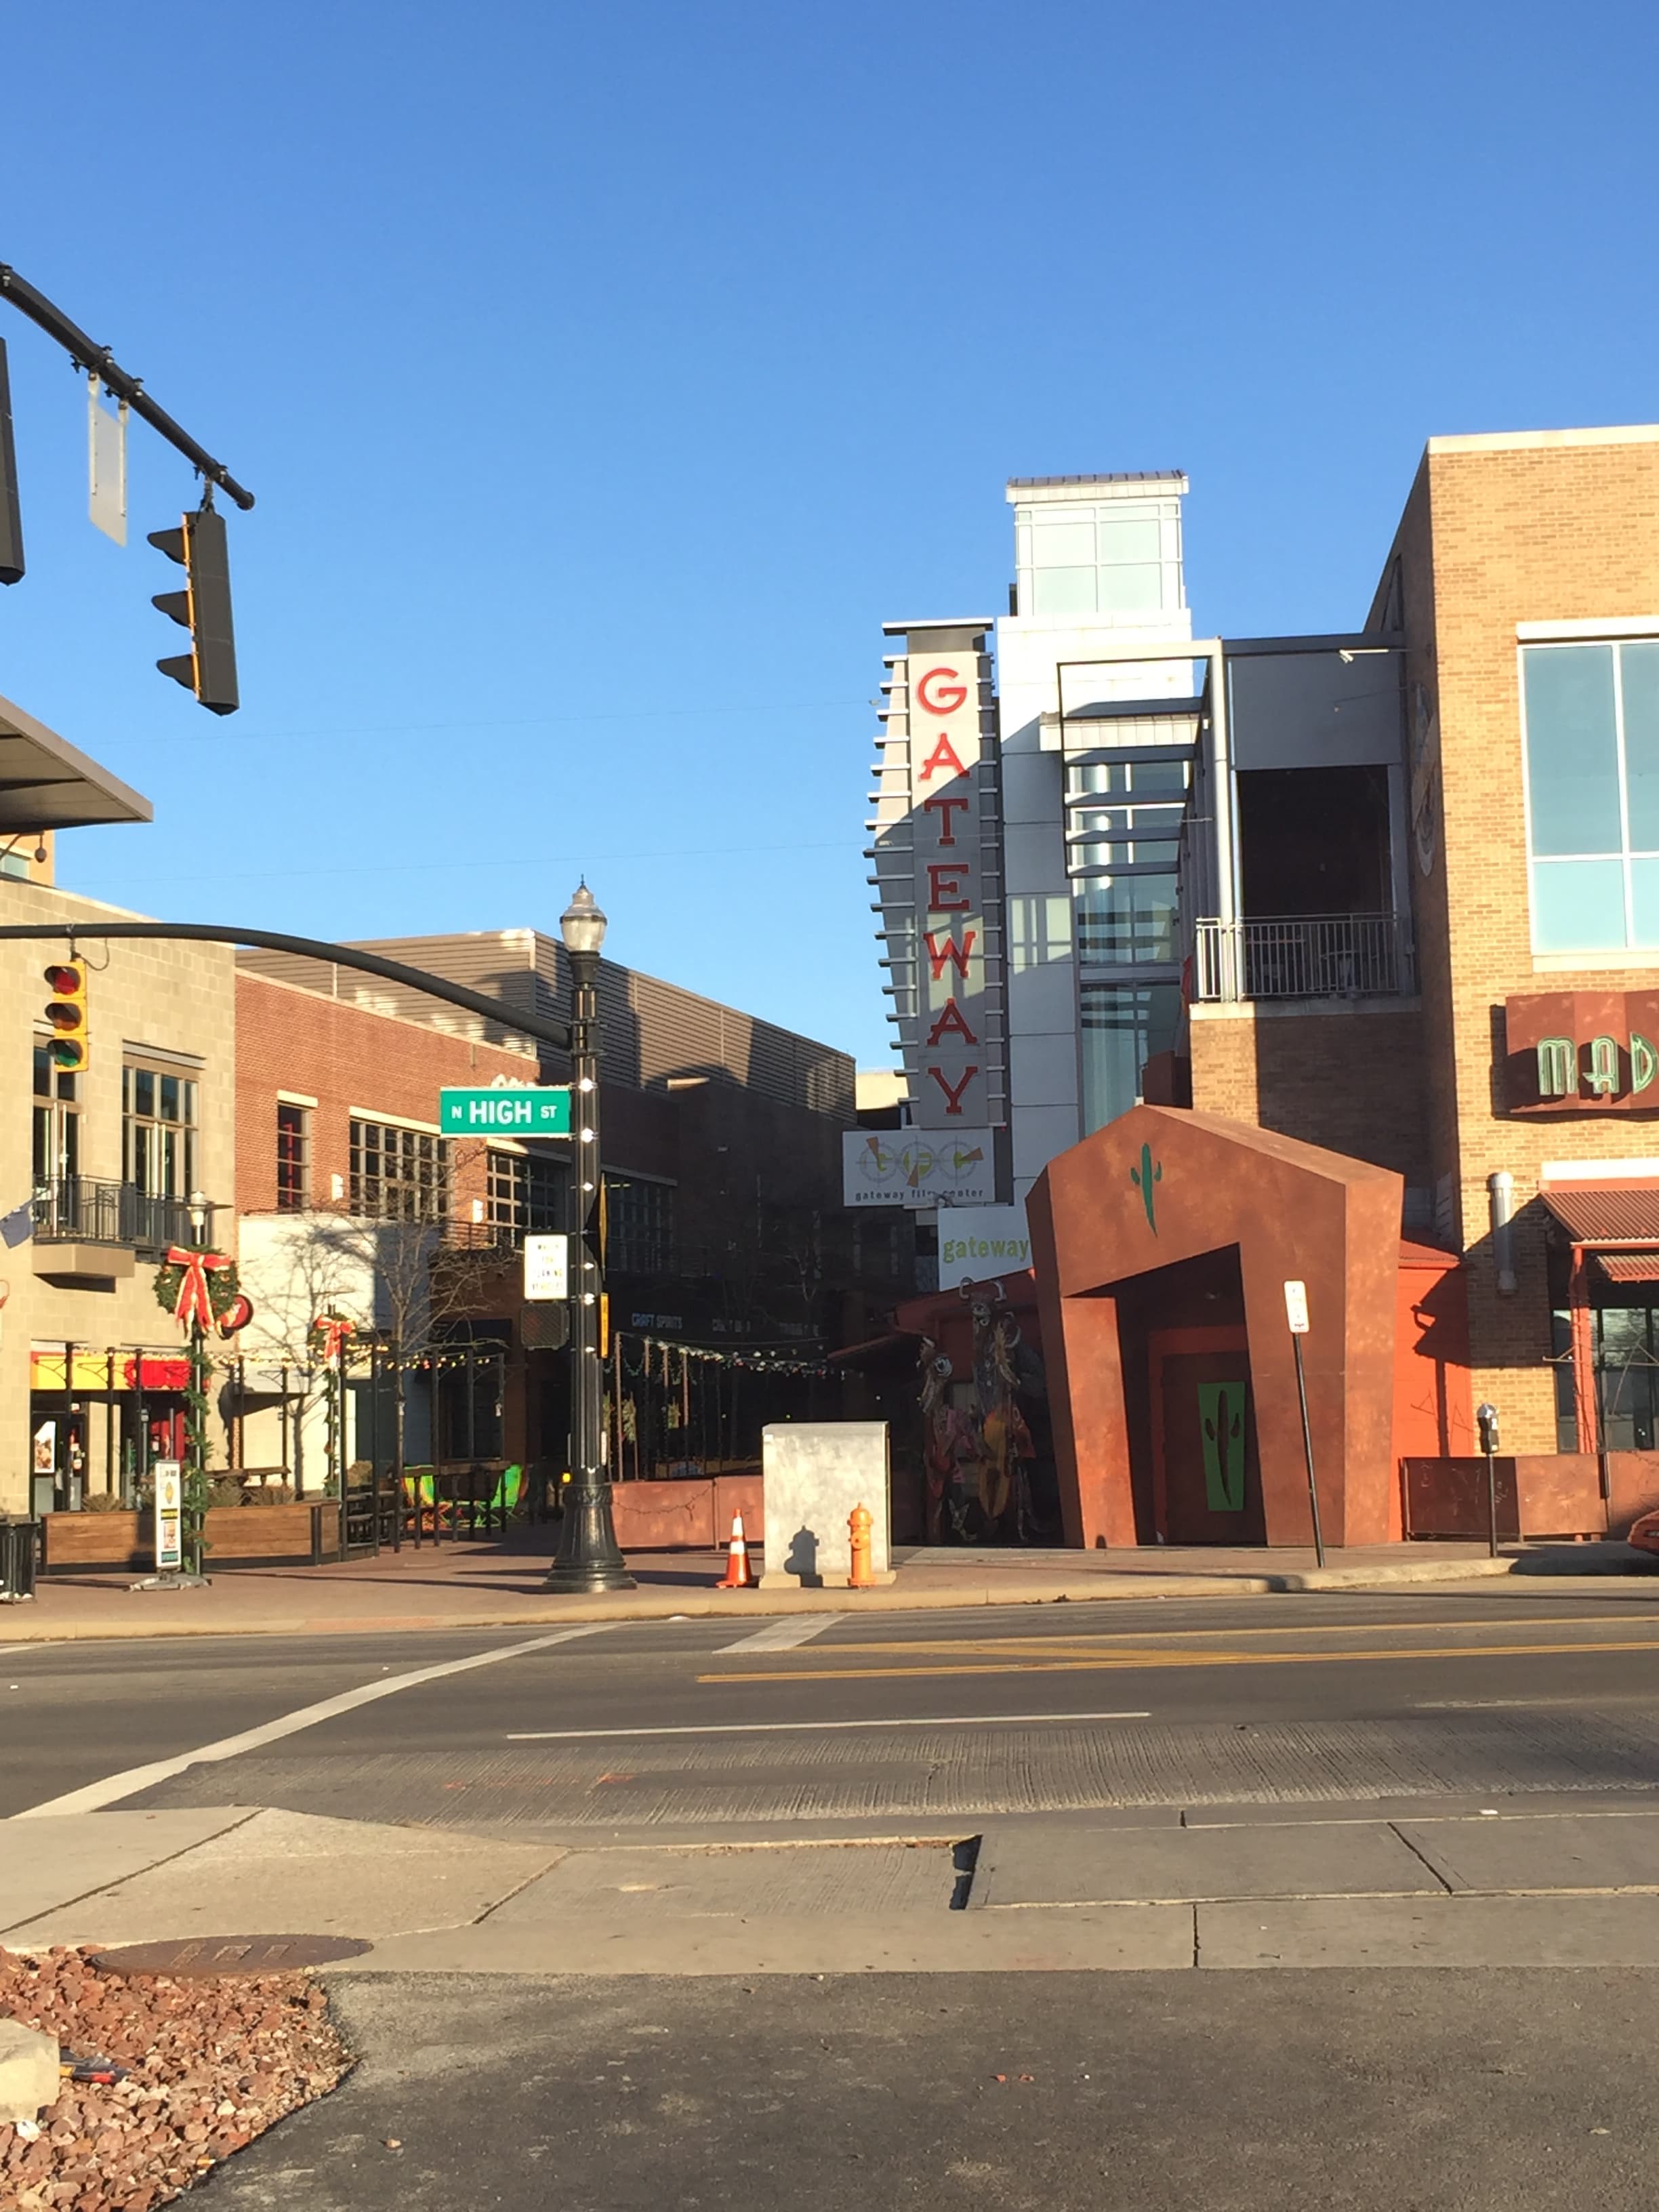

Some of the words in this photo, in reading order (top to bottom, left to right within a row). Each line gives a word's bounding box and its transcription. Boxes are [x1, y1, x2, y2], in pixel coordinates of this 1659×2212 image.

[916, 668, 978, 1115] GATEWAY
[1537, 1032, 1658, 1096] MAD
[451, 1105, 463, 1119] N
[469, 1100, 533, 1125] HIGH
[540, 1105, 558, 1119] ST
[855, 1190, 905, 1202] gateway
[943, 1235, 1029, 1263] gateway
